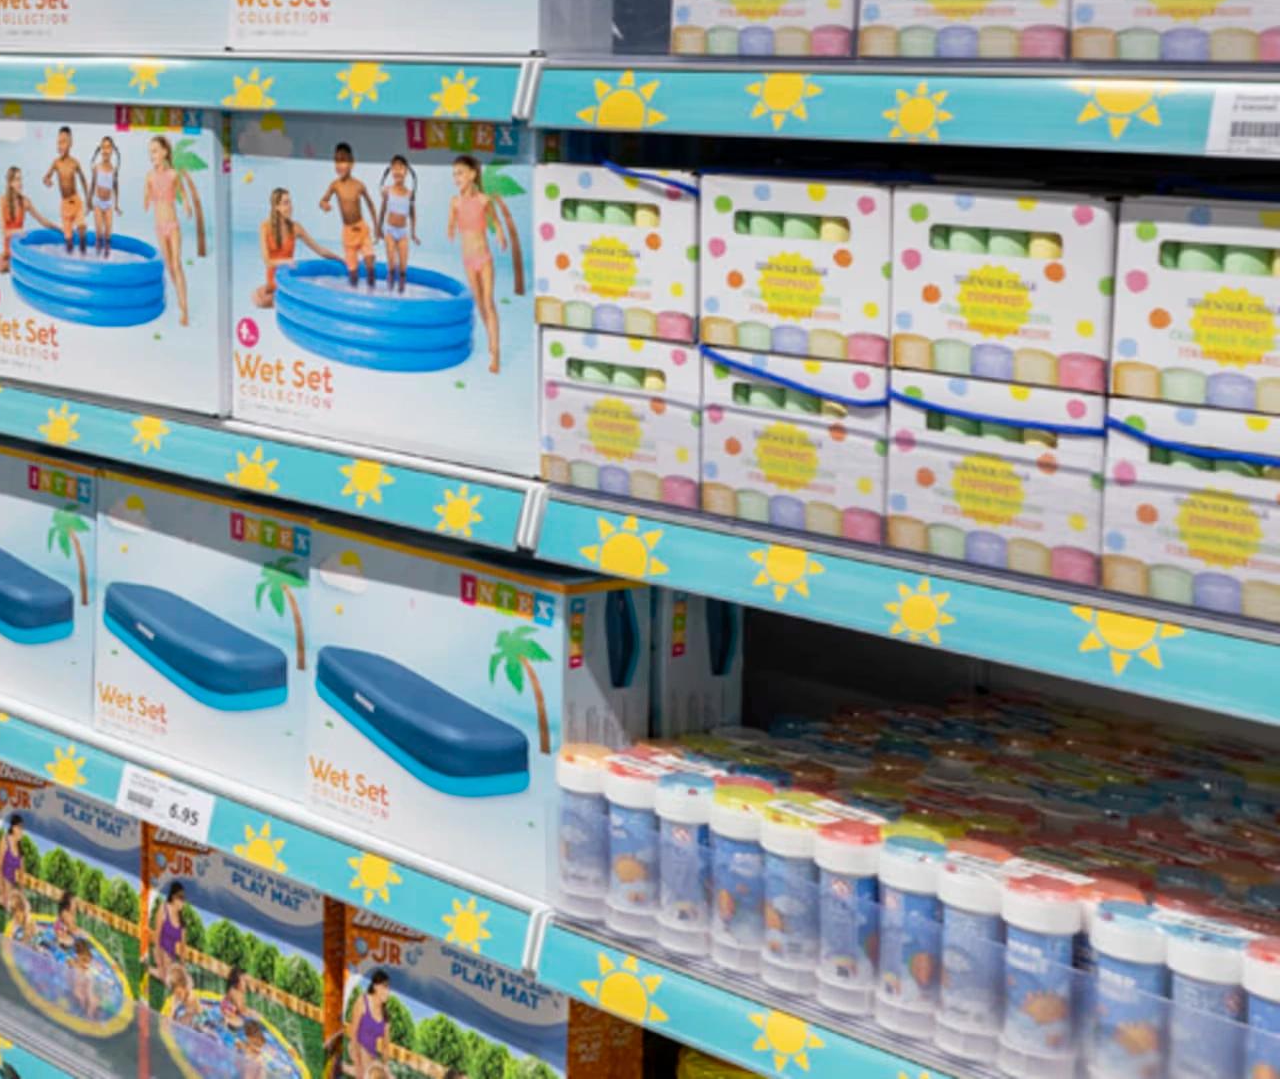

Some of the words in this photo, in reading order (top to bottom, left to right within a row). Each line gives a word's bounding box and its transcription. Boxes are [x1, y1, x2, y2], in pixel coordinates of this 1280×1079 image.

[238, 10, 331, 24] COLLECTION
[116, 104, 202, 134] INTEX
[407, 118, 519, 155] INTEX
[27, 320, 59, 348] Set
[235, 351, 285, 386] Wet
[291, 357, 333, 393] Set
[239, 385, 333, 410] COLLECTION
[28, 464, 91, 504] INTEX
[230, 512, 311, 555] INTEX
[461, 572, 556, 627] INTEX
[98, 682, 133, 713] Wet
[136, 692, 168, 724] Set
[310, 755, 352, 792] Wet
[355, 768, 390, 806] Set
[10, 788, 32, 810] JR
[168, 802, 200, 827] 6.95
[63, 802, 92, 826] PLAY
[96, 817, 123, 838] MAT
[169, 850, 193, 876] JR
[231, 870, 267, 897] PLAY
[271, 887, 302, 912] MAT
[372, 936, 402, 966] JR
[450, 961, 496, 992] PLAY
[501, 978, 539, 1010] MAT
